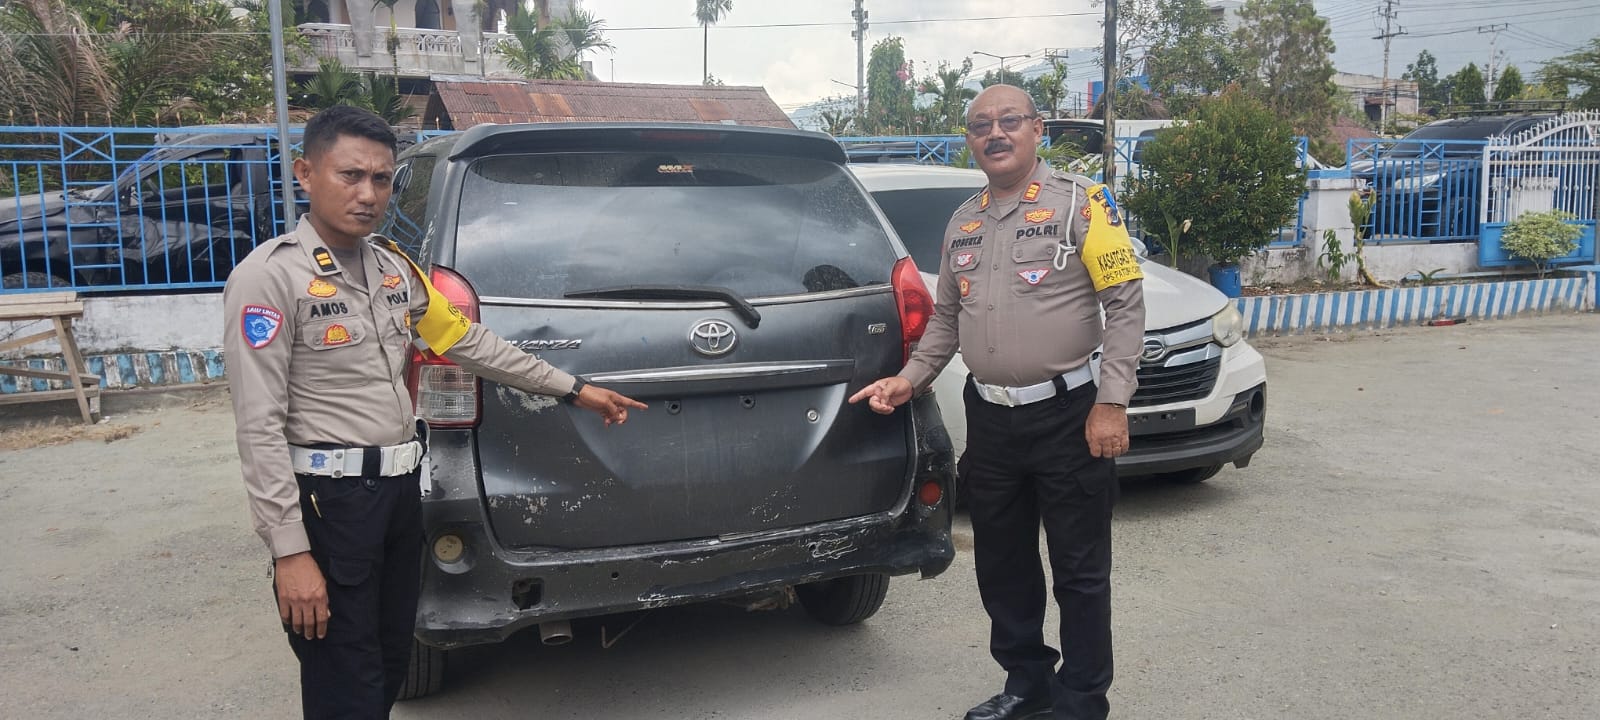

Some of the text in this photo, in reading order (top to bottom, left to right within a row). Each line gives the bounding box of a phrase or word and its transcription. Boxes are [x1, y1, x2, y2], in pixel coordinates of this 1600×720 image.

[1016, 224, 1058, 240] POLRI
[310, 302, 348, 318] AMOS
[505, 339, 583, 350] VANZA
